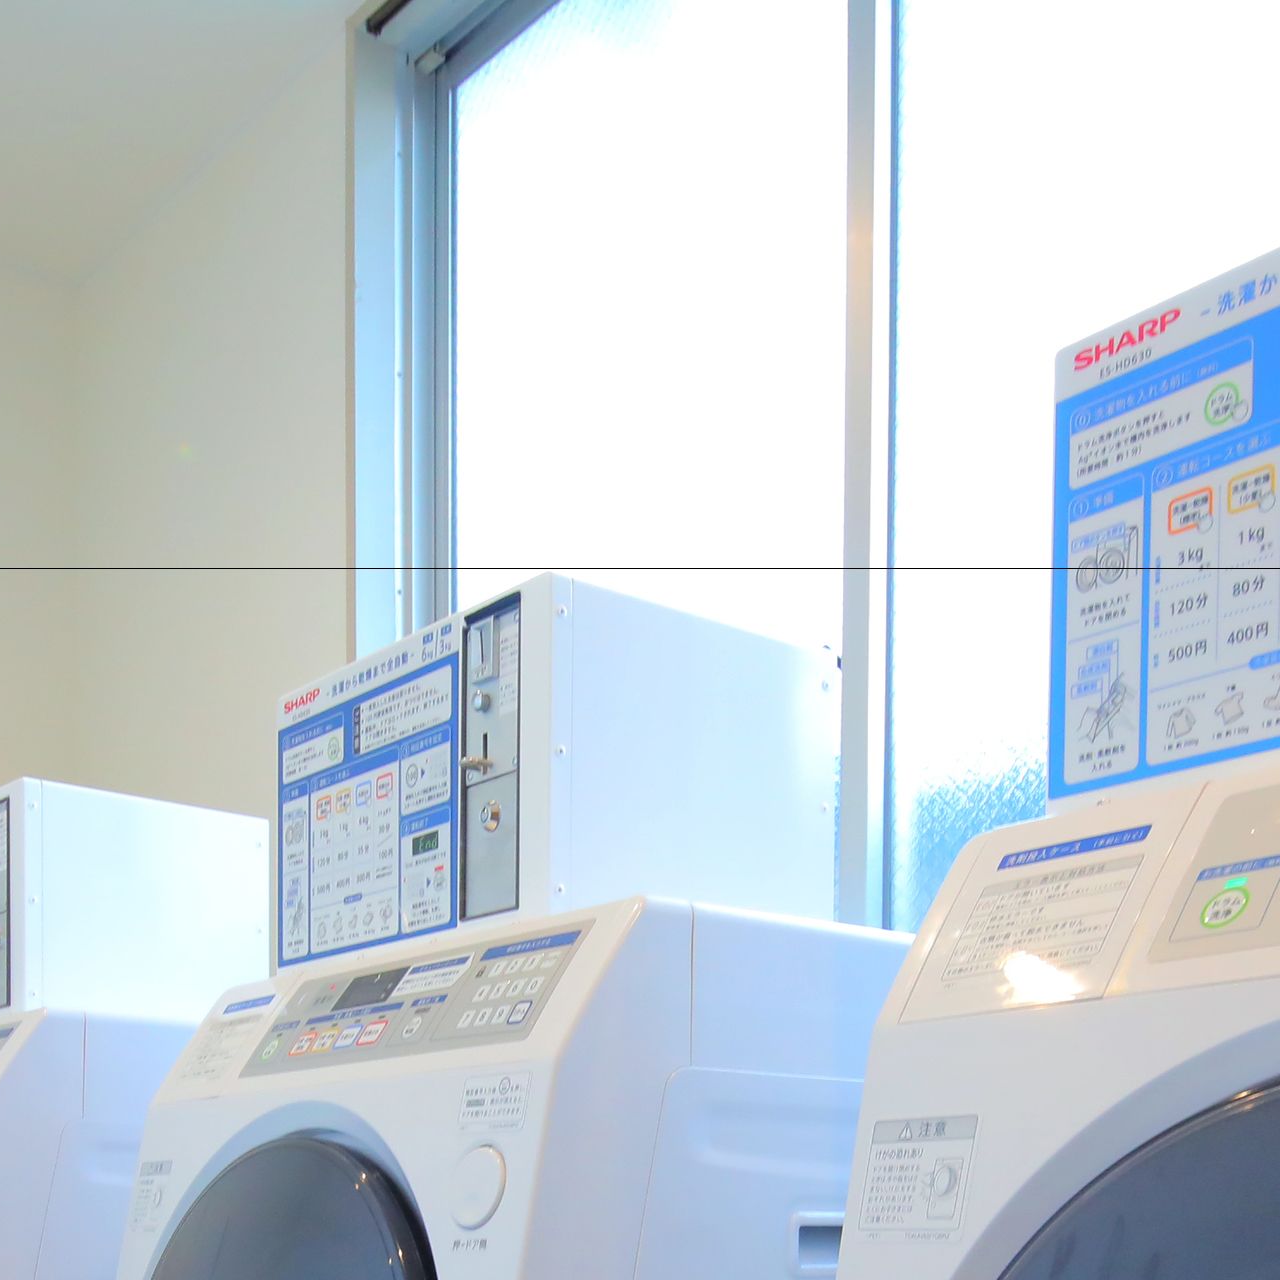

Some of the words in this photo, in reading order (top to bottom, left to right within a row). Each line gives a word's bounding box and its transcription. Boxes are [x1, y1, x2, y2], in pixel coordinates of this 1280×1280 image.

[1073, 308, 1182, 372] SHARP
[1098, 346, 1153, 380] ES-HD630
[1177, 546, 1205, 566] 3kg
[1231, 573, 1266, 598] 80分
[1169, 591, 1209, 617] 120分
[1226, 621, 1270, 646] 400円
[1167, 639, 1209, 664] 500円
[283, 687, 321, 715] SHARP
